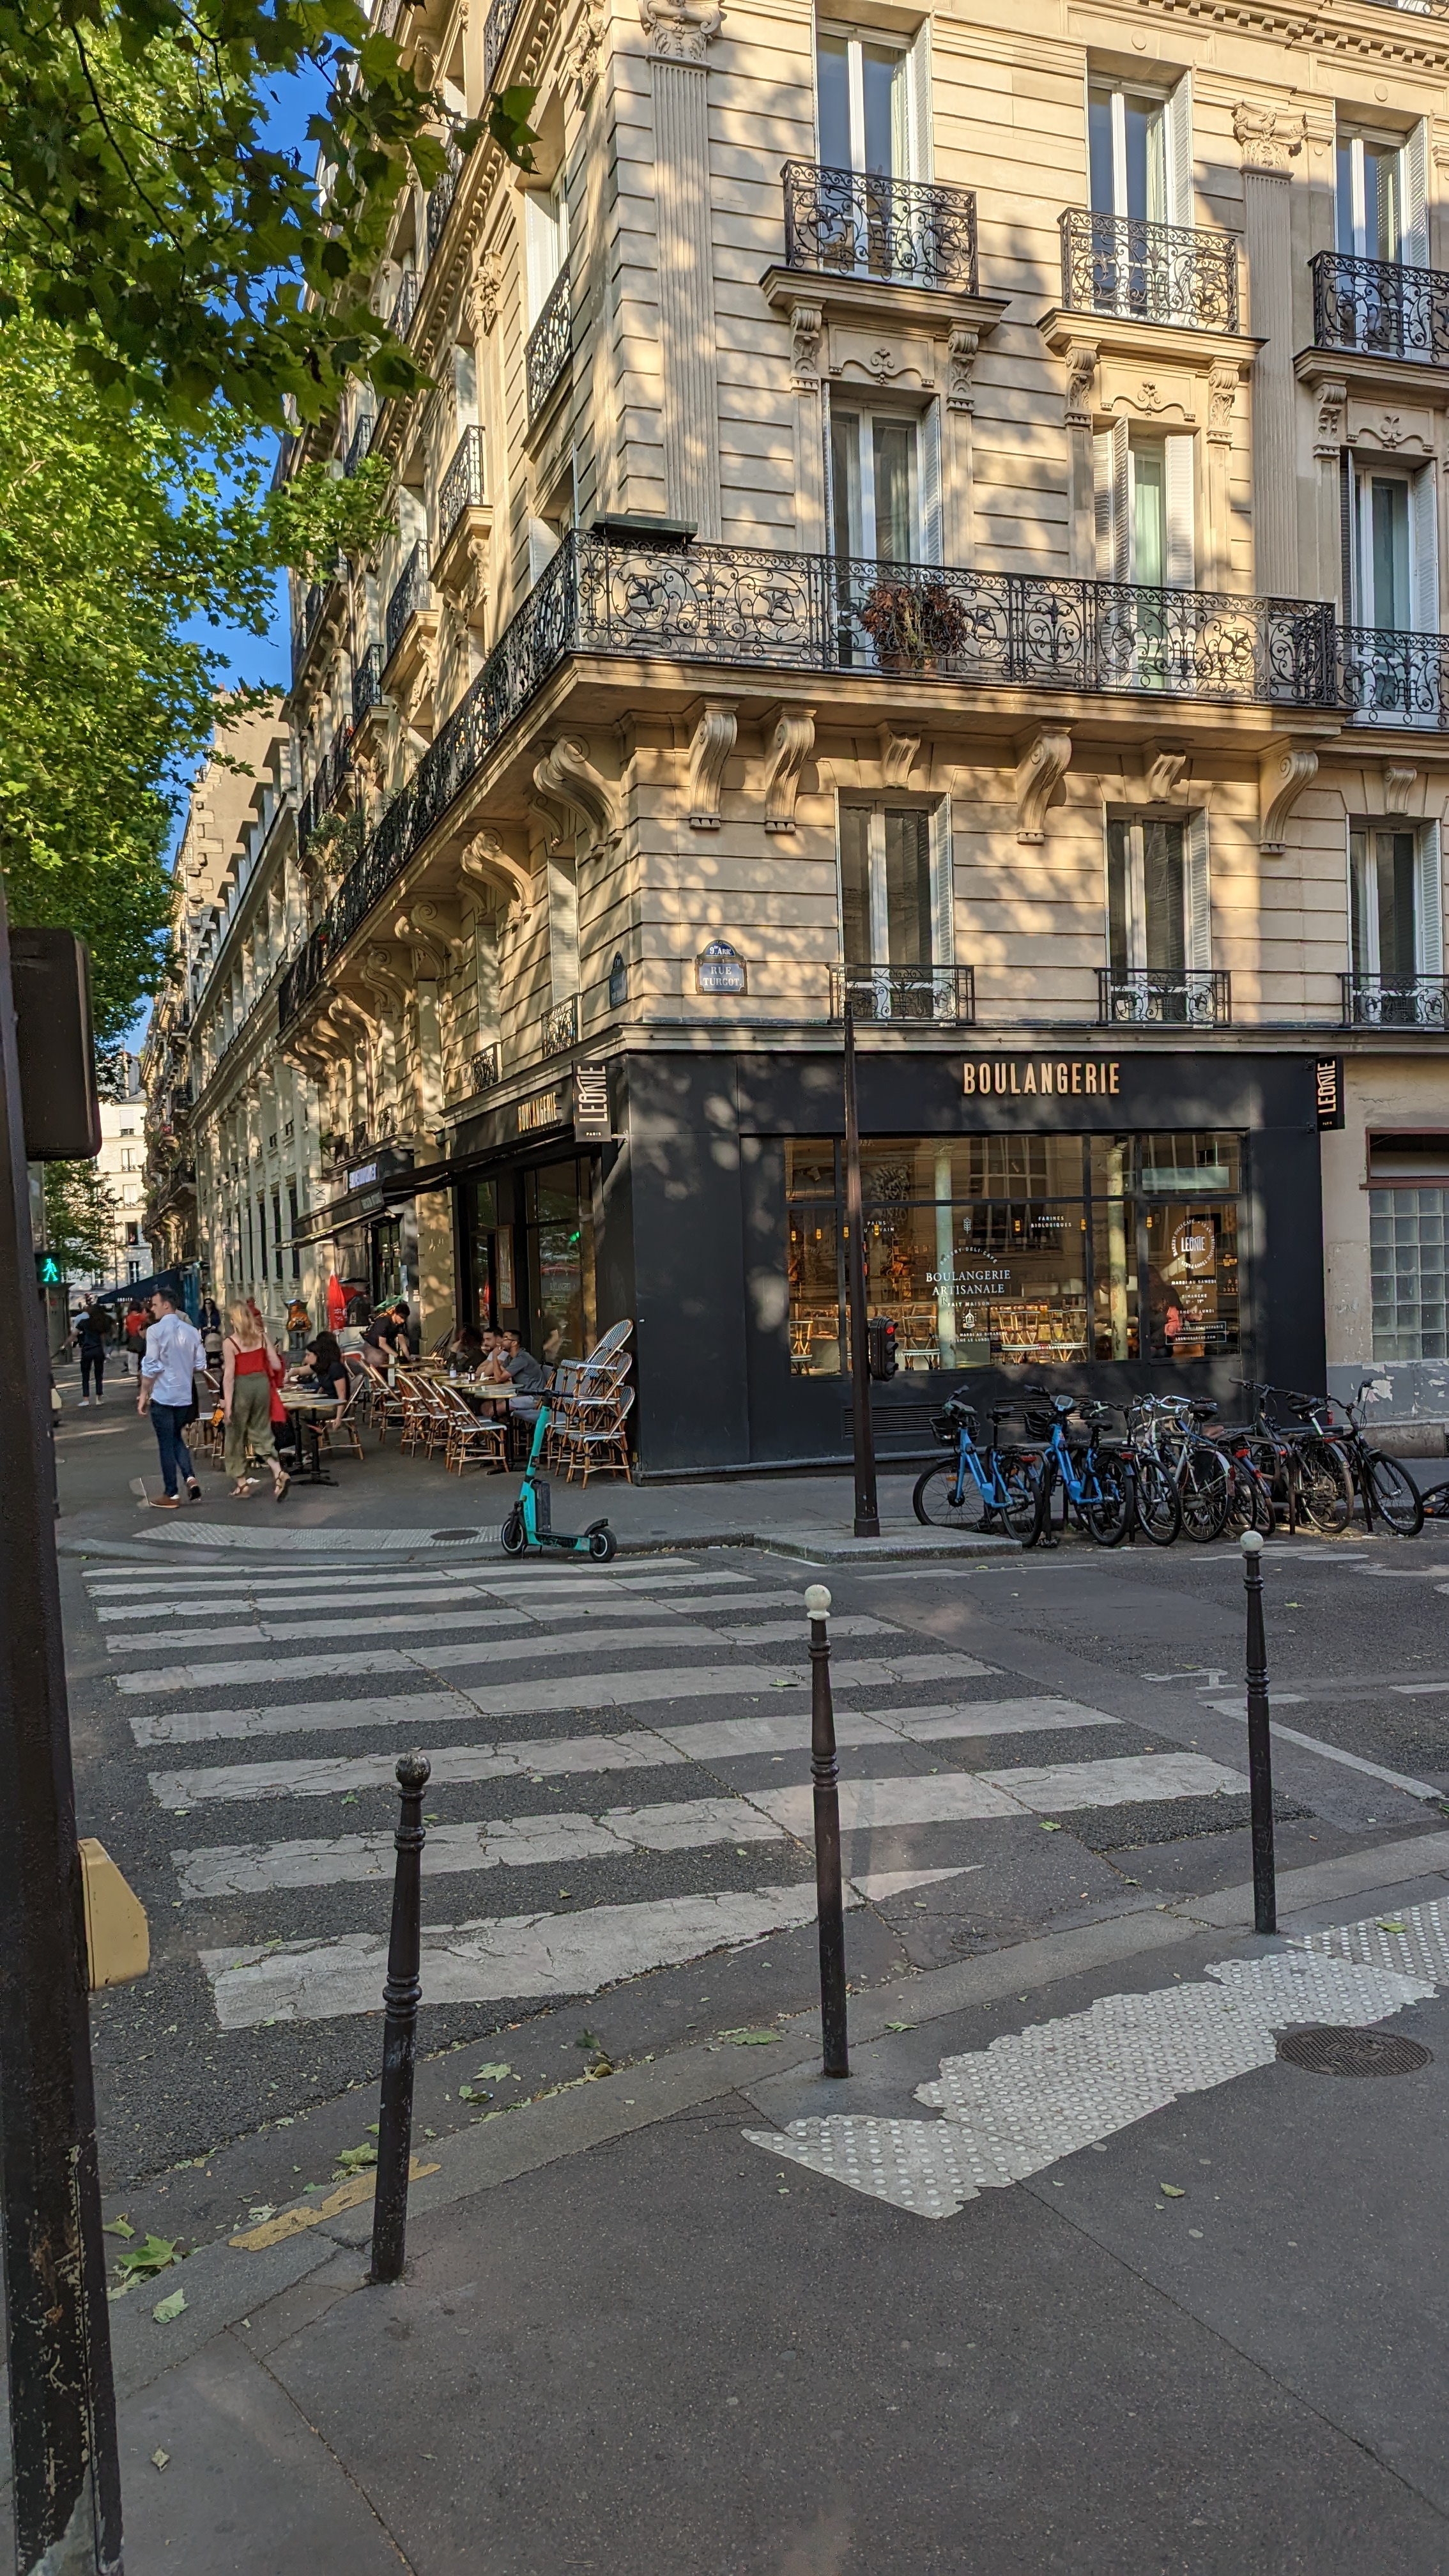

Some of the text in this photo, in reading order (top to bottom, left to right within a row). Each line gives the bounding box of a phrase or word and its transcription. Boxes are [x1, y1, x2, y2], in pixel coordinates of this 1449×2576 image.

[710, 966, 732, 975] RUE
[963, 1062, 1120, 1094] BOULANGERIE
[518, 1091, 558, 1133] BOULANGERIE
[926, 1269, 1011, 1282] BOULANGERIE
[931, 1284, 1005, 1296] ARTISANALE
